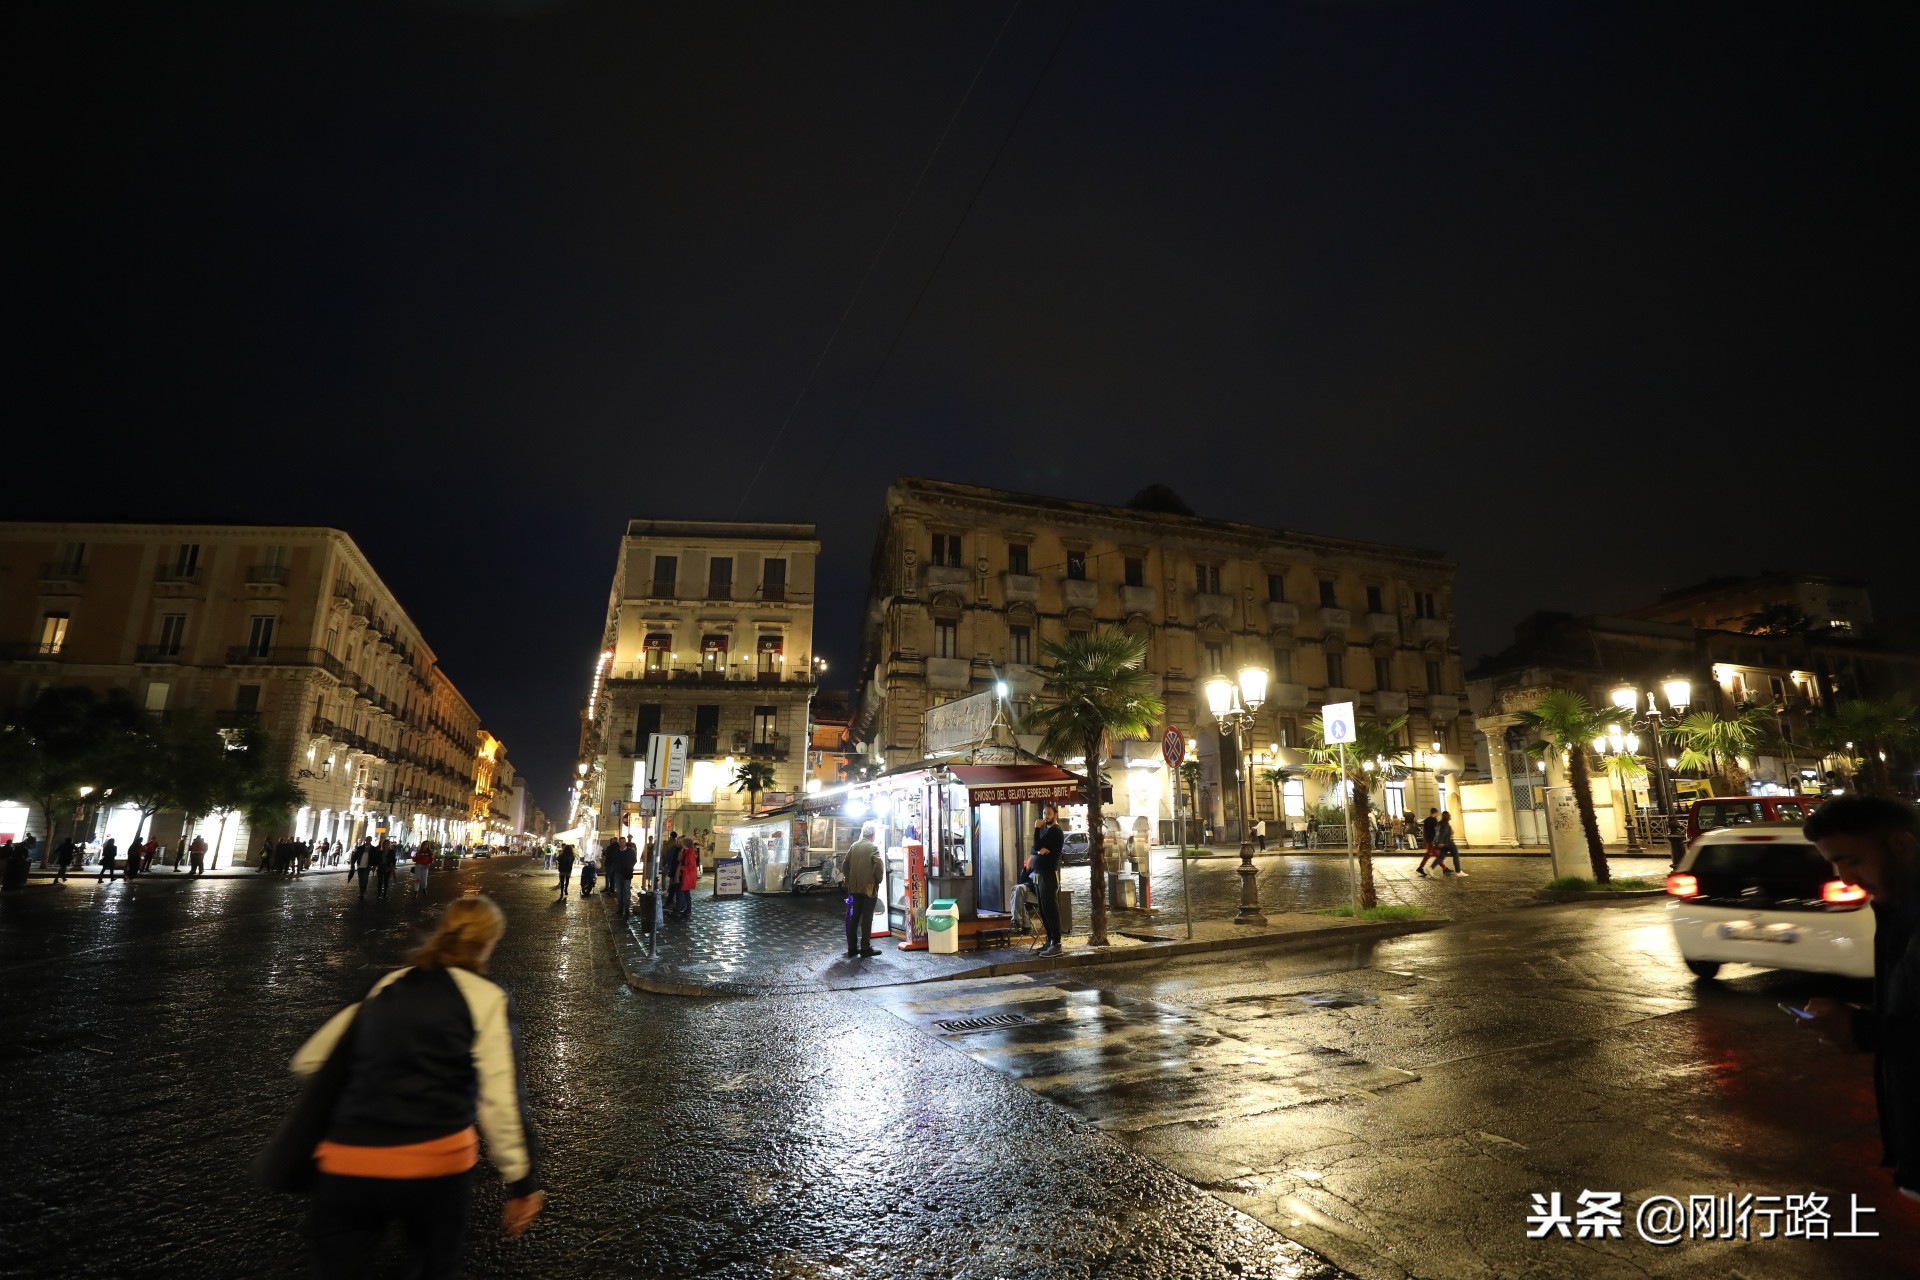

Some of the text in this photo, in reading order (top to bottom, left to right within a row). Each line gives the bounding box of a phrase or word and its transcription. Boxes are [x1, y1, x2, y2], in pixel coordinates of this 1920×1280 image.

[974, 790, 996, 802] CHIOSCO
[996, 789, 1006, 801] DEL
[1007, 788, 1026, 800] GELATO
[1027, 787, 1051, 799] ESPRESSO
[910, 848, 919, 908] STICKER
